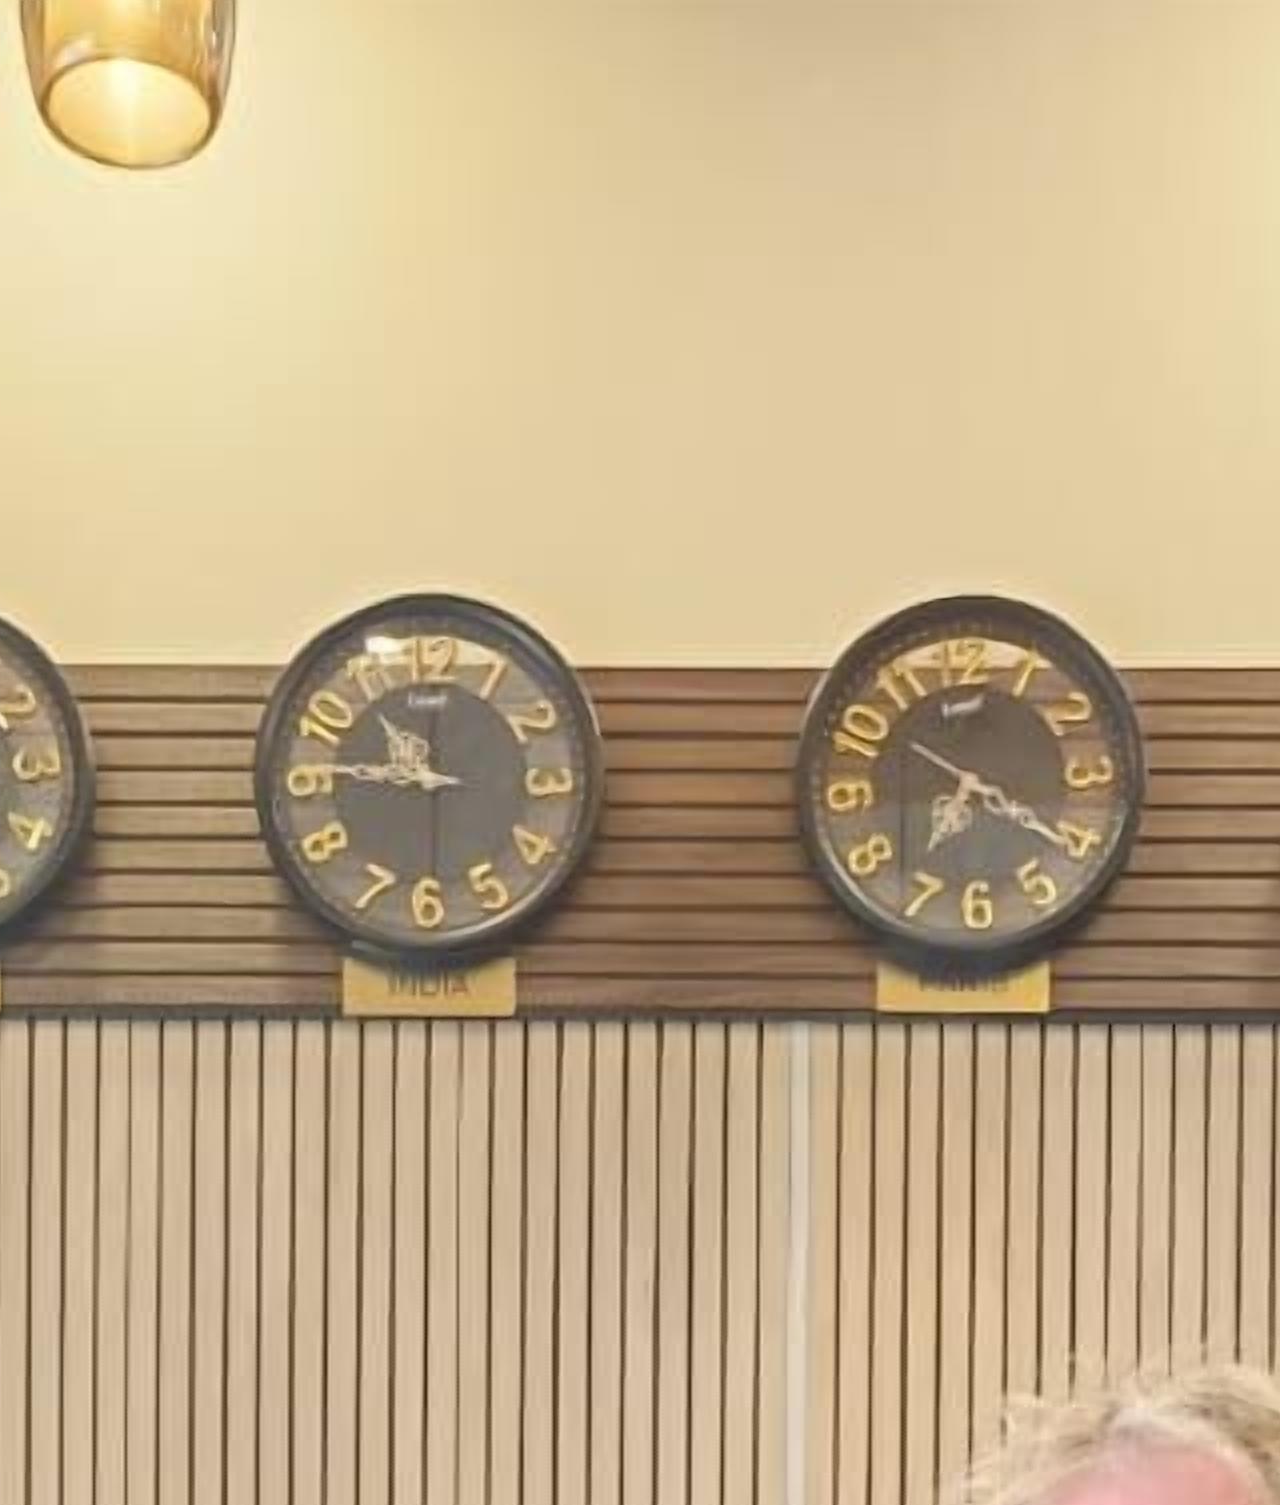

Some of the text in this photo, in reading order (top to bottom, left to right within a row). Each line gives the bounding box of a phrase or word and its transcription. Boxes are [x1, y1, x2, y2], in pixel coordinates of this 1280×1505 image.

[347, 654, 396, 701] 11
[408, 637, 456, 683] 12
[479, 660, 507, 699] 1
[933, 640, 992, 686] 12
[1013, 656, 1037, 696] 1
[878, 668, 928, 710] 11
[300, 691, 352, 745] 10
[506, 700, 555, 743] 2
[833, 705, 889, 757] 10
[1039, 692, 1092, 735] 2
[12, 753, 61, 780] 3
[288, 766, 333, 796] 9
[525, 767, 572, 795] 3
[1065, 755, 1113, 787] 3
[828, 782, 872, 810] 9
[7, 812, 52, 849] 4
[302, 822, 348, 862] 8
[513, 825, 555, 864] 4
[1057, 821, 1101, 857] 4
[848, 834, 892, 875] 8
[355, 863, 395, 908] 7
[469, 863, 508, 908] 5
[904, 871, 944, 916] 7
[1017, 857, 1056, 904] 5
[412, 877, 444, 927] 6
[963, 880, 992, 929] 6
